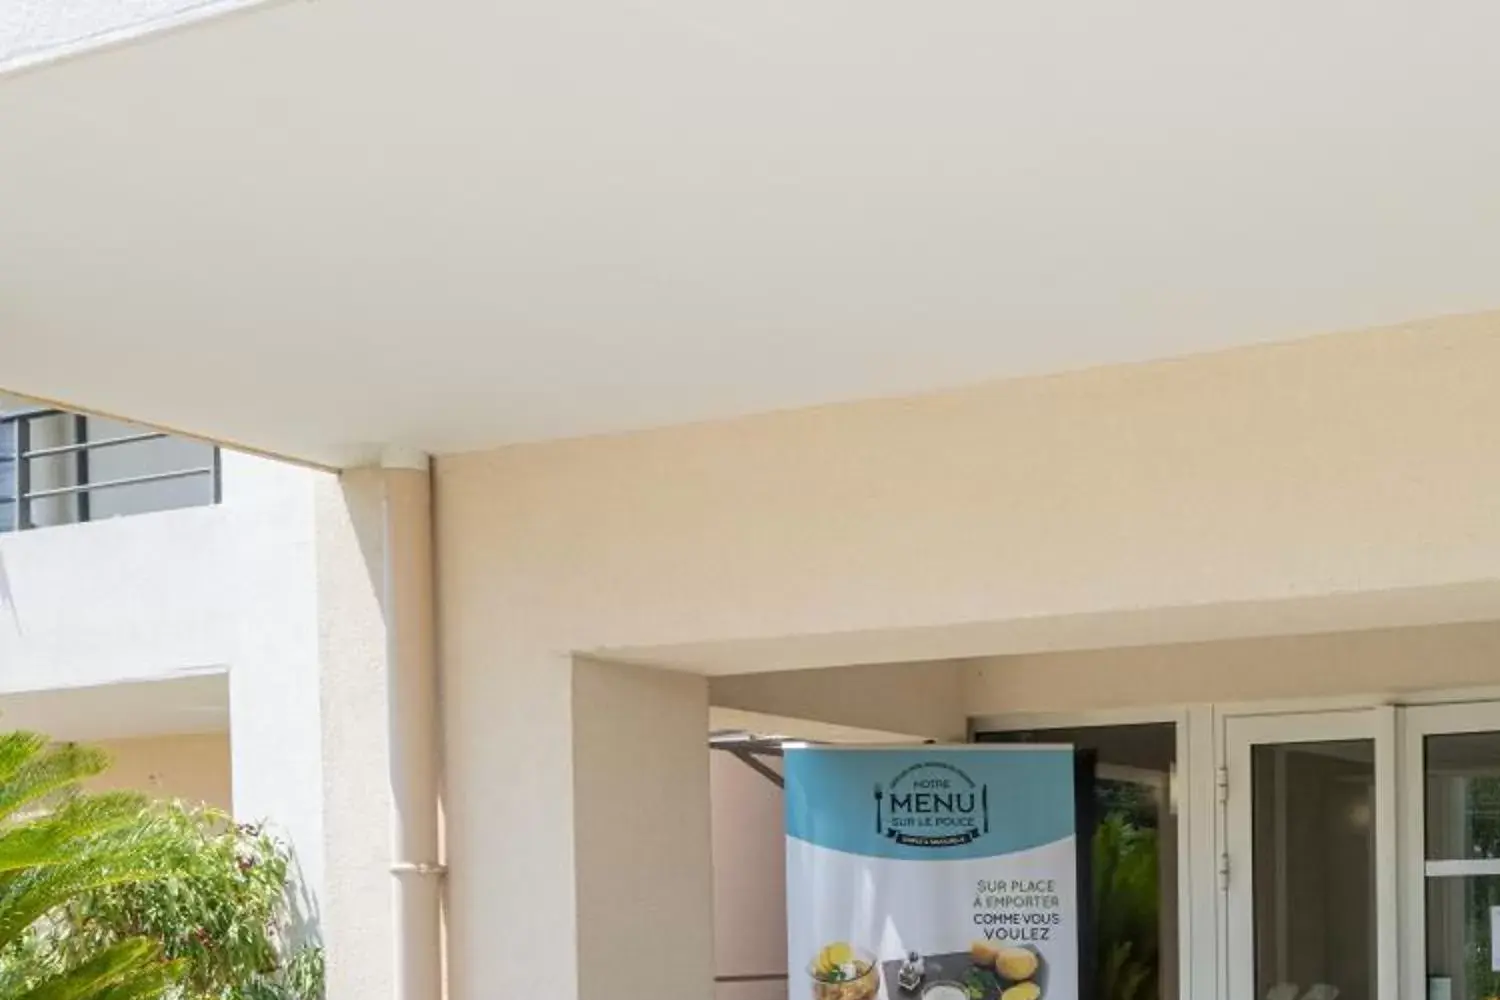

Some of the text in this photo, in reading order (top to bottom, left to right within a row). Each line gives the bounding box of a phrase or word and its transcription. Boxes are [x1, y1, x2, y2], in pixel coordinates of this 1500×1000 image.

[890, 792, 975, 813] MENU
[891, 817, 975, 827] SUR LE POUCE
[977, 878, 1056, 893] SUR PLACE
[985, 894, 1059, 908] EMPORTER
[973, 913, 1060, 925] COMME VOUS
[983, 927, 1050, 941] VOULEZ
